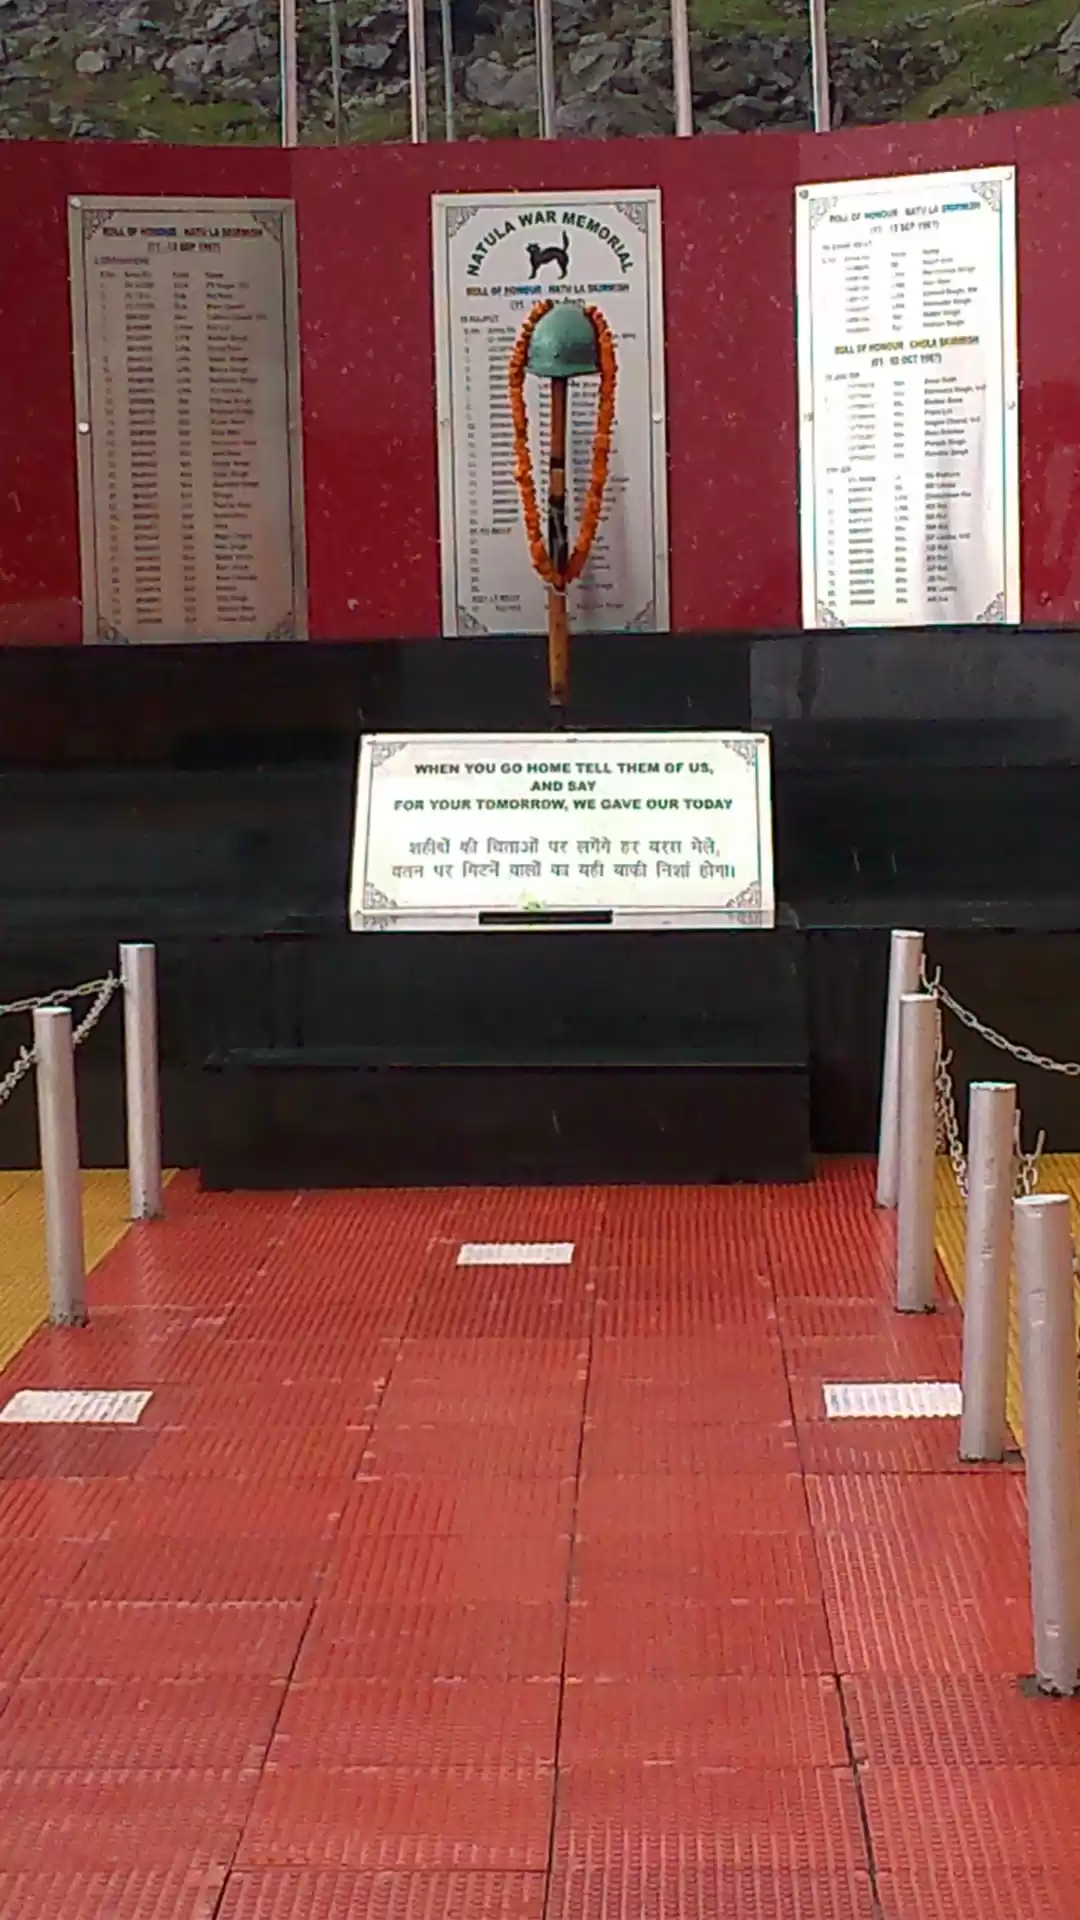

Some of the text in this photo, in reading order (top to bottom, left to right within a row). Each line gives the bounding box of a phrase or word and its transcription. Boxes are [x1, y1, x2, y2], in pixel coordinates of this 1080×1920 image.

[466, 210, 635, 277] NATULA WAR MEMORIAL
[415, 762, 715, 775] WHEN YOU GO HOME TELL THEM OF US,
[530, 780, 597, 792] AND SAY
[393, 798, 733, 812] FOR YOUR TOMORROW, WE GAVE OUR TODAY
[459, 836, 479, 855] की
[486, 836, 540, 854] चिताओं
[547, 840, 569, 854] पर
[620, 840, 641, 855] हर
[391, 864, 424, 879] वतन
[433, 864, 454, 879] पर
[508, 860, 542, 878] वालों
[550, 864, 570, 877] का
[577, 859, 605, 878] यही
